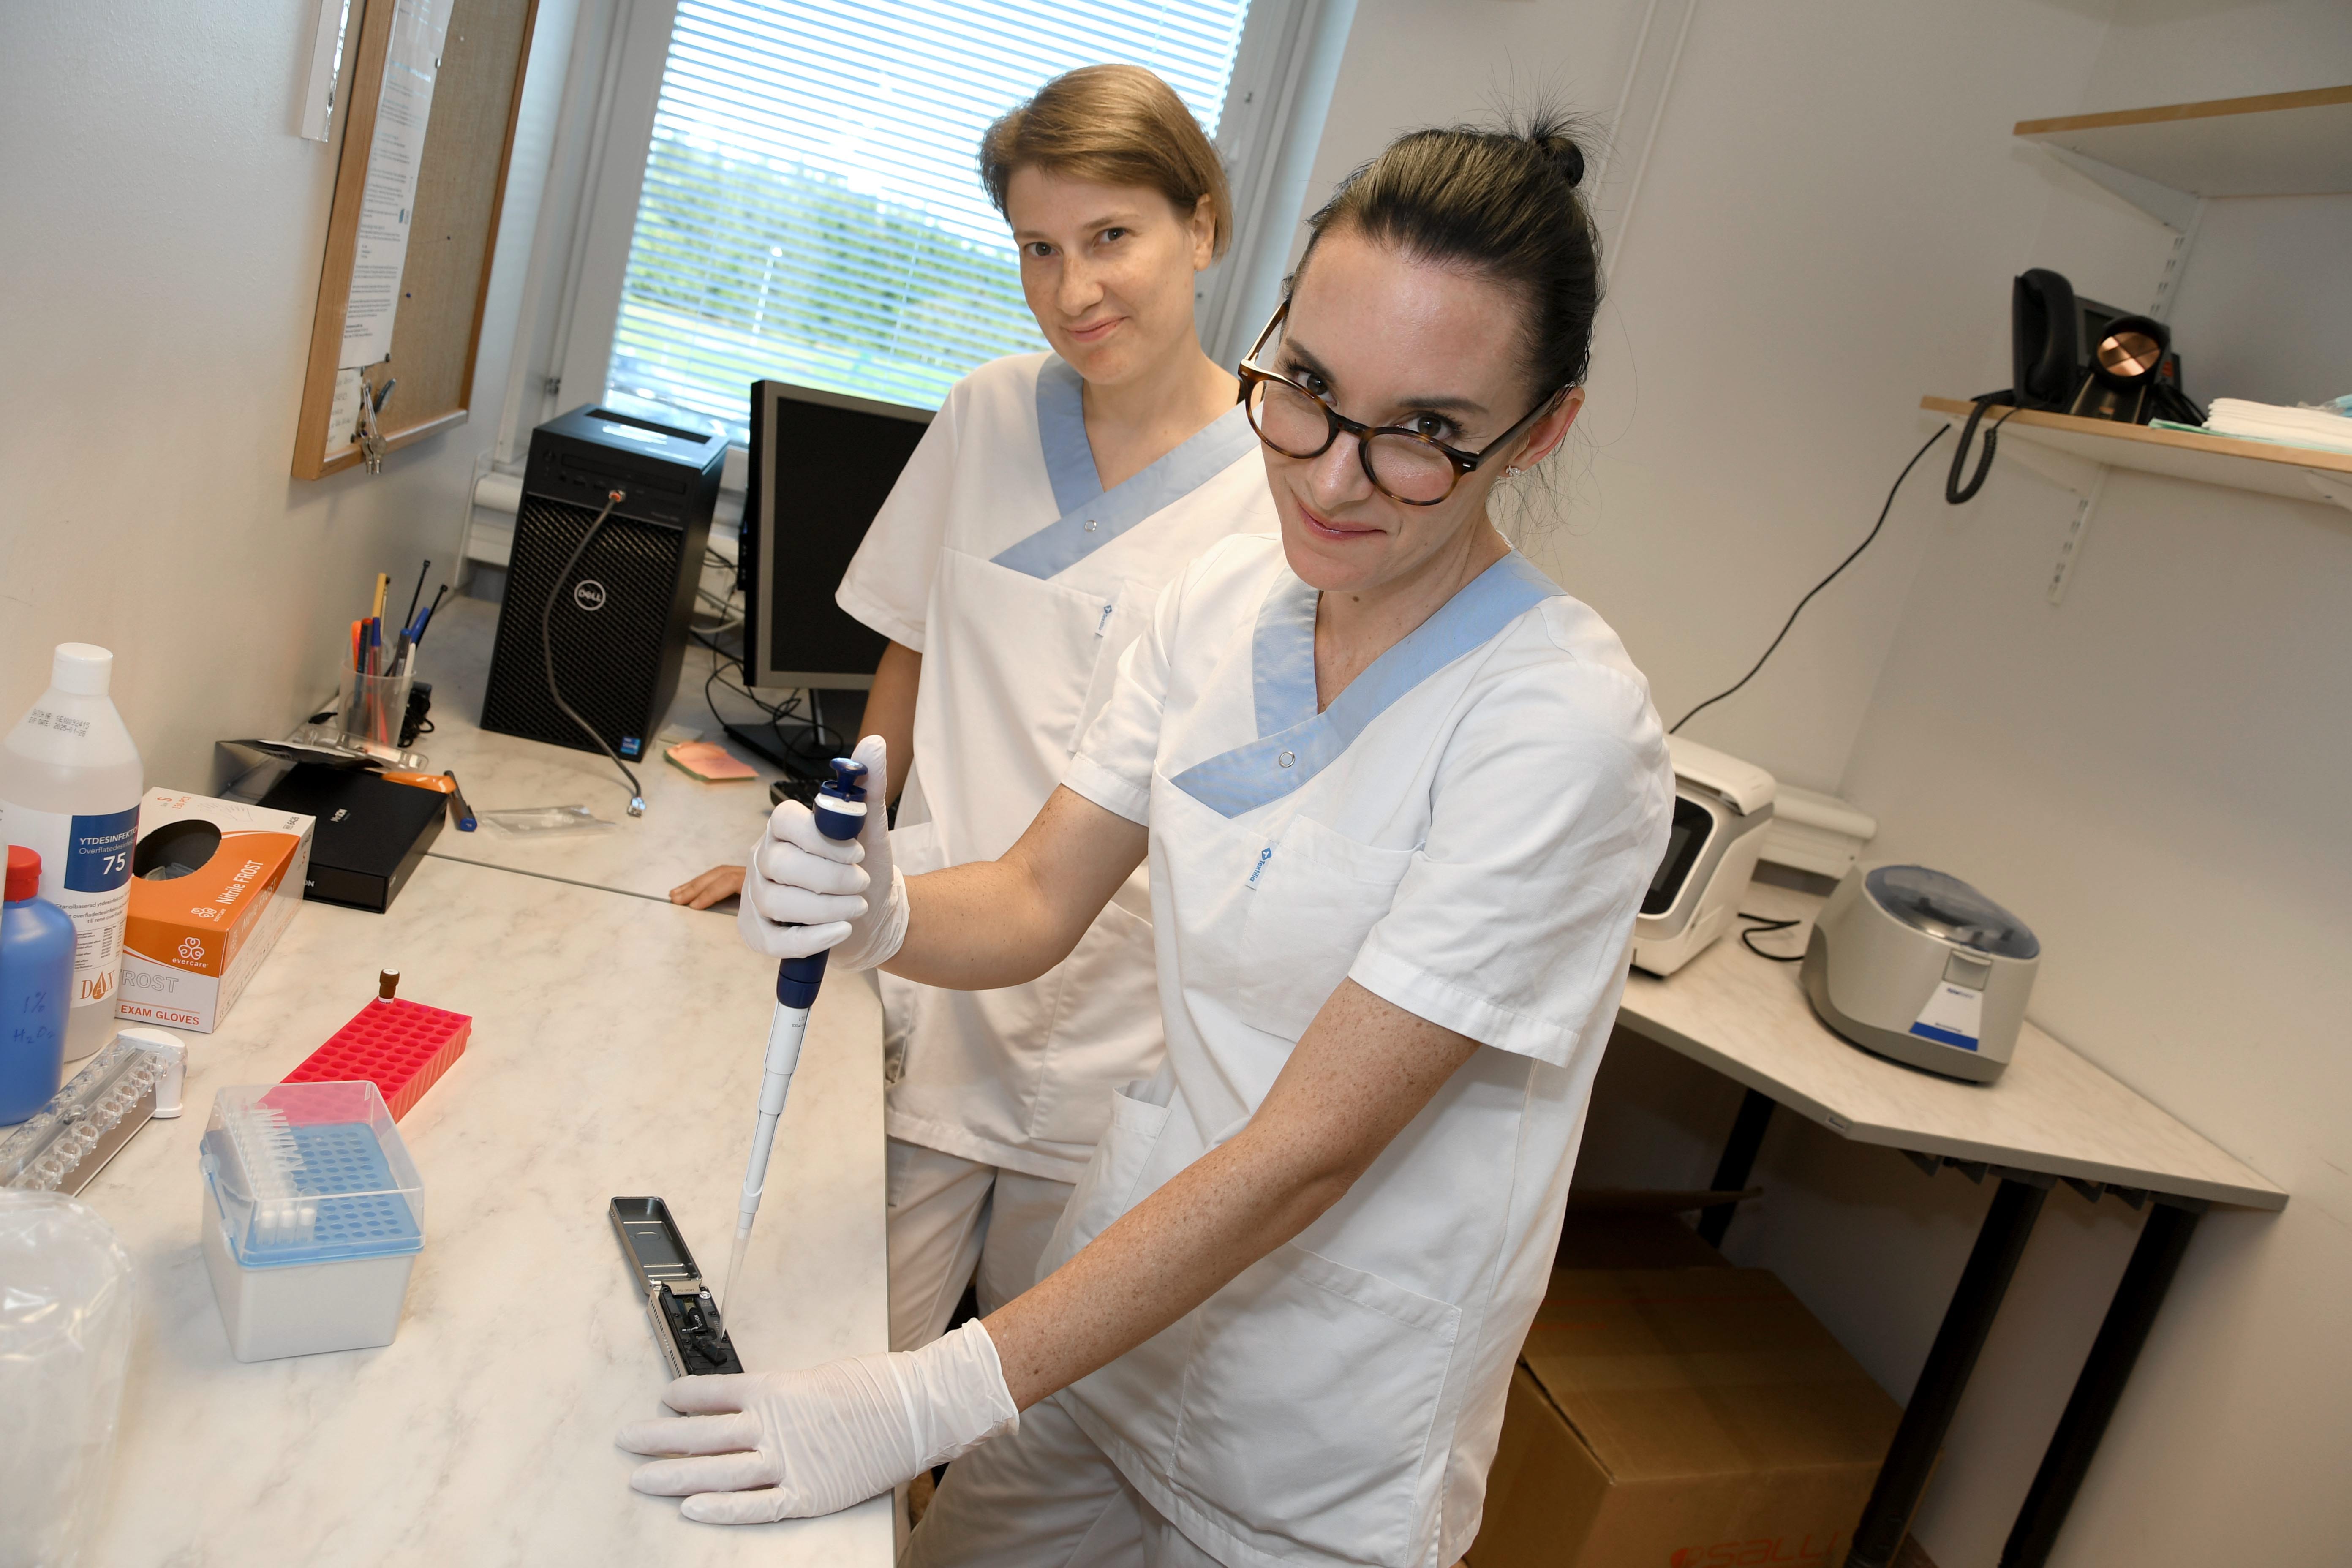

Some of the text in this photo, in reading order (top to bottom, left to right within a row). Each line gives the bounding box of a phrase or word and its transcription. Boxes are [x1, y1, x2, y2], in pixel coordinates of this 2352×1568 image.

[578, 588, 601, 602] DELL
[103, 852, 126, 875] 75
[215, 859, 264, 905] Nitrile FROST
[172, 958, 207, 968] evercare
[80, 970, 115, 999] DAX
[120, 969, 179, 993] ROST
[121, 1005, 200, 1025] EXAM GLOVES
